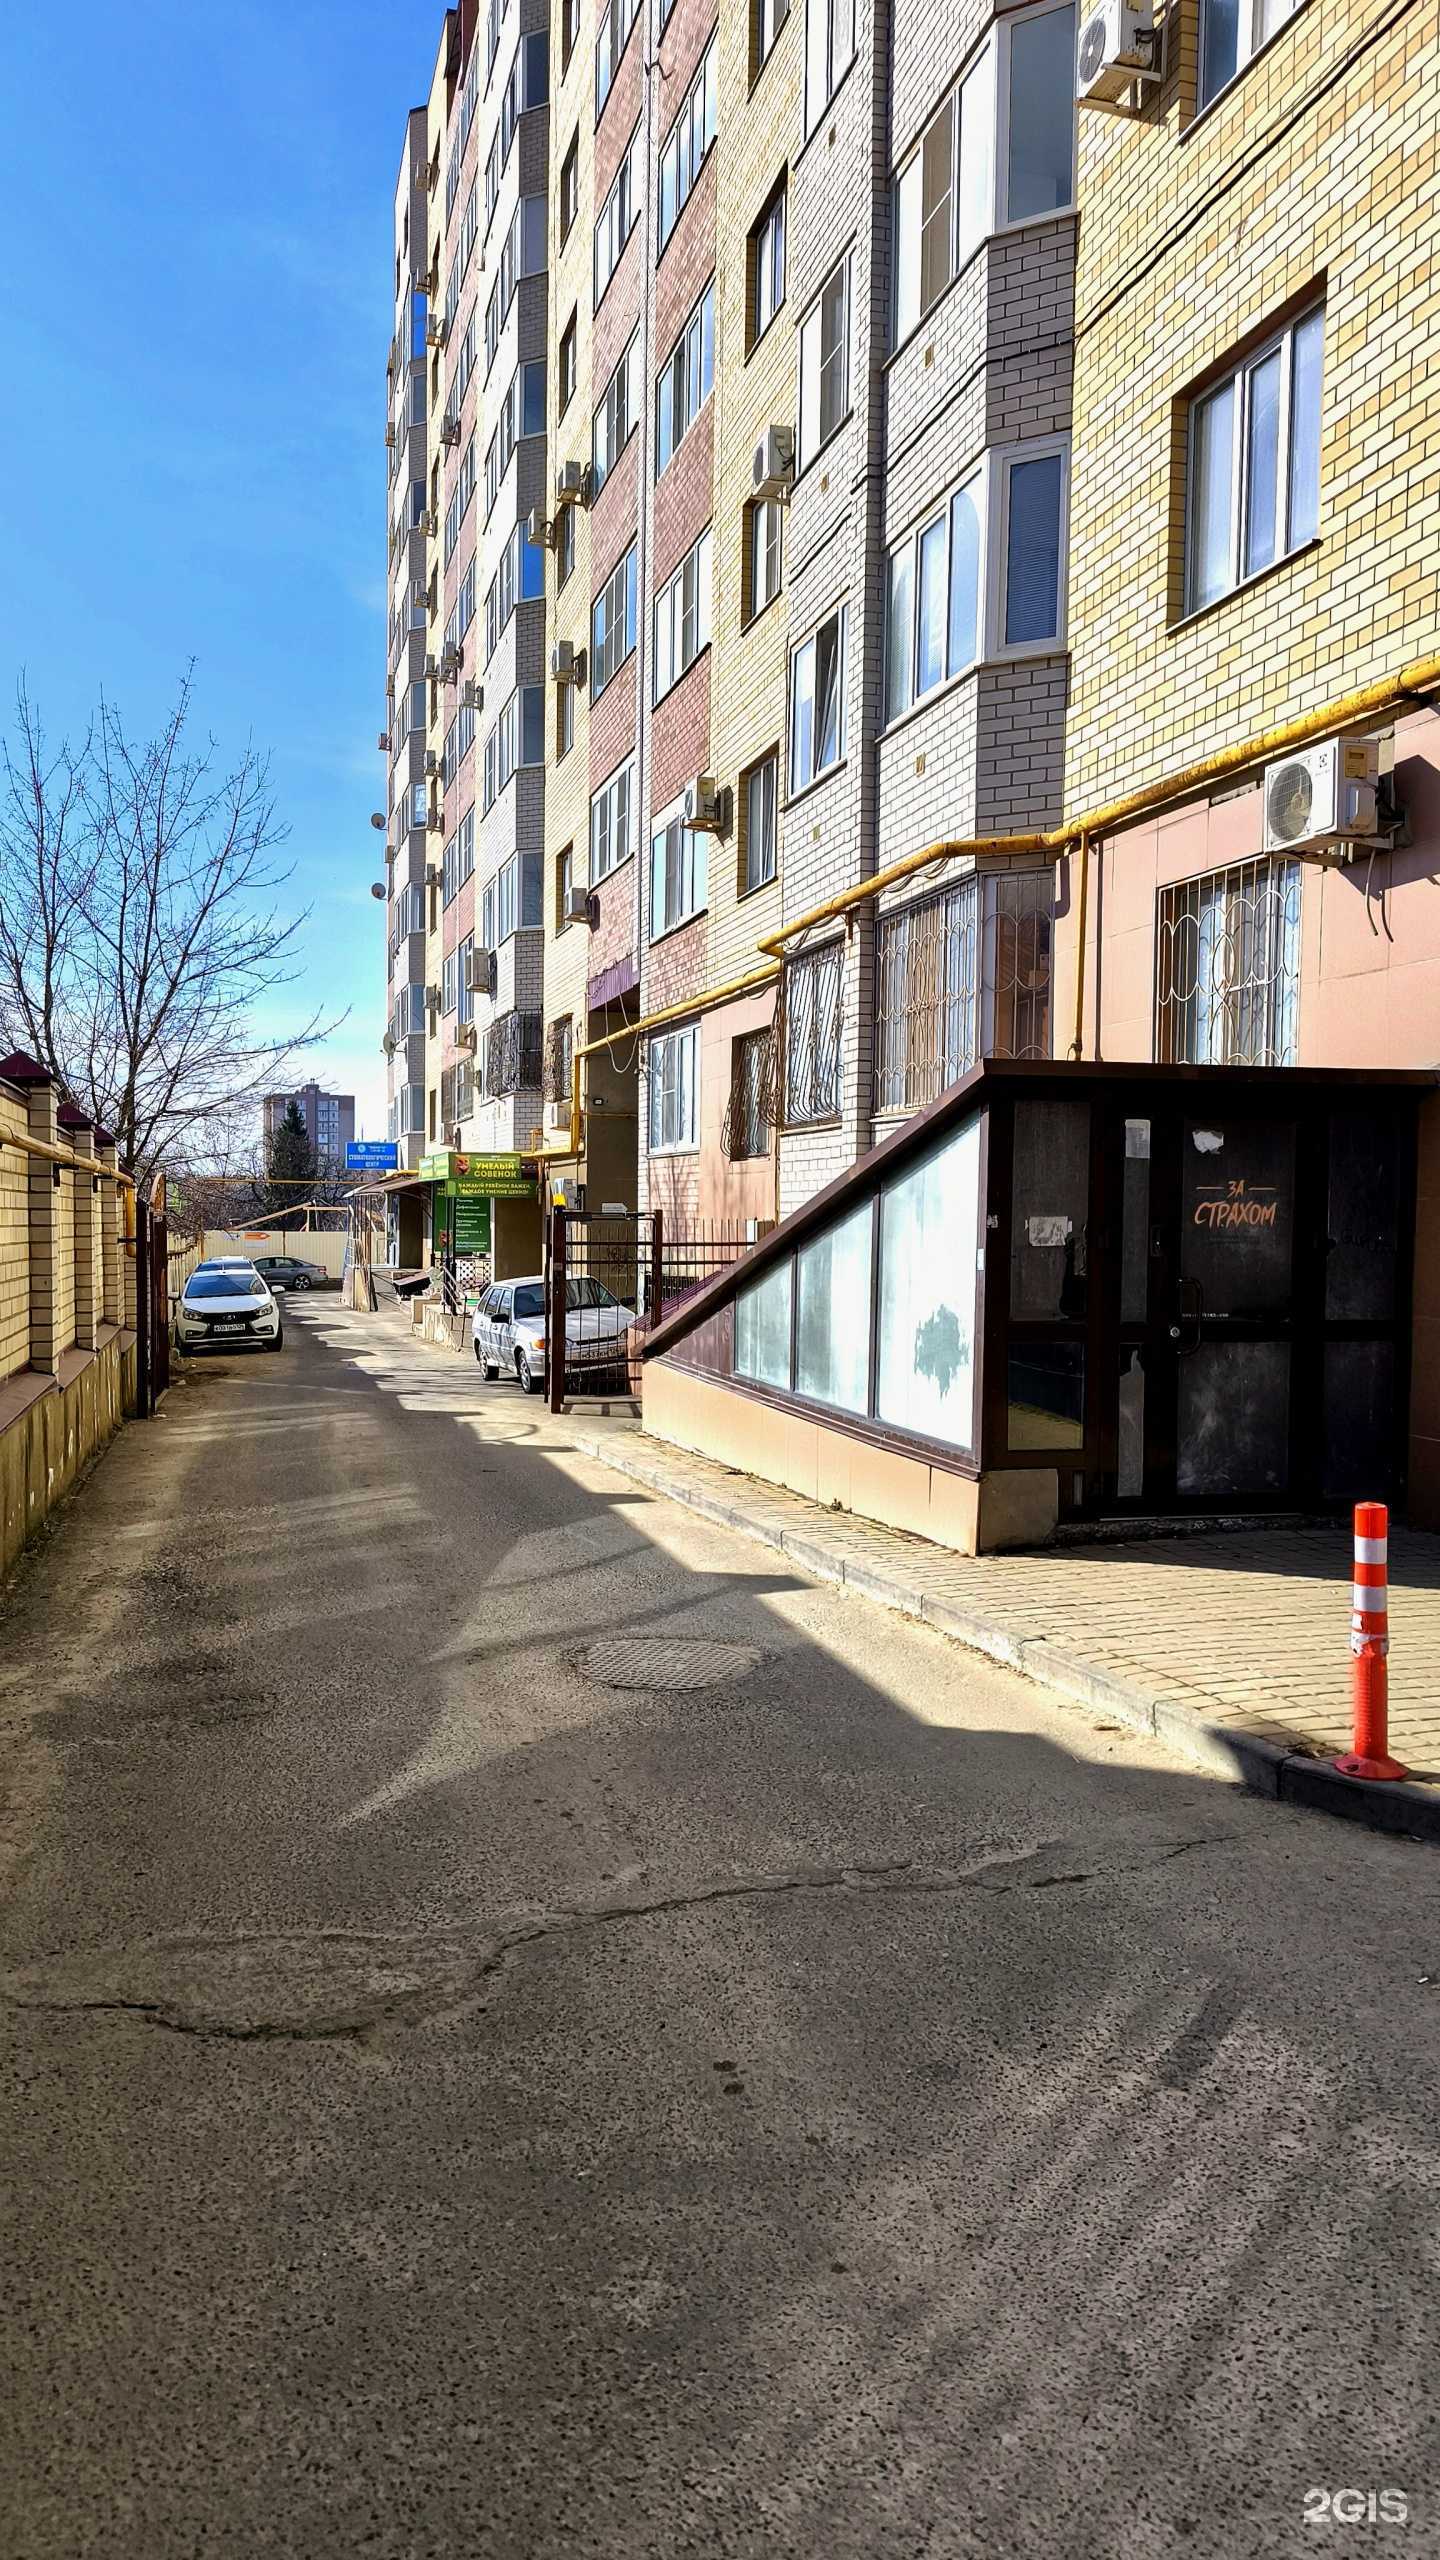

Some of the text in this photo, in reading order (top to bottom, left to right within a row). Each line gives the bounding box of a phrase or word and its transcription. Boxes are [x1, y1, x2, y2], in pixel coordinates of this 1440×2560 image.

[476, 1161, 514, 1170] УМЕЛЫЙ
[474, 1170, 517, 1178] СОВЕНОК
[1227, 1179, 1245, 1199] ЗА
[1194, 1200, 1277, 1228] СТРАХОМ
